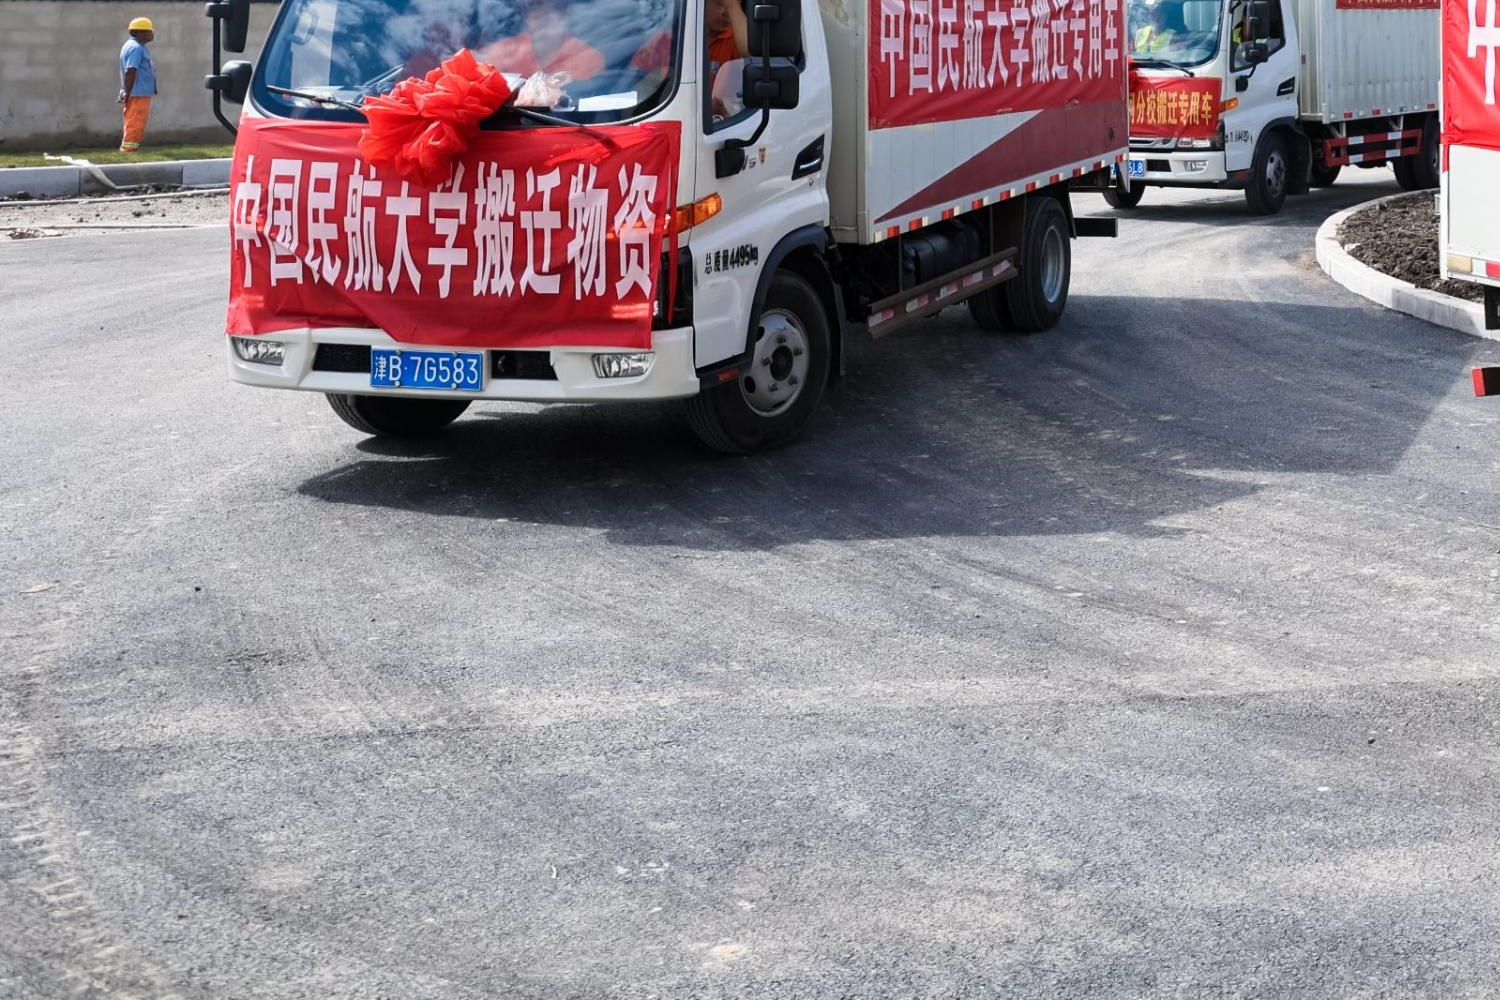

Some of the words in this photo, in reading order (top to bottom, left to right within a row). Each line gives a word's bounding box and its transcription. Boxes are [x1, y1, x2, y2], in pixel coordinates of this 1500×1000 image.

[231, 154, 658, 299] 中国民航大学搬迁物资
